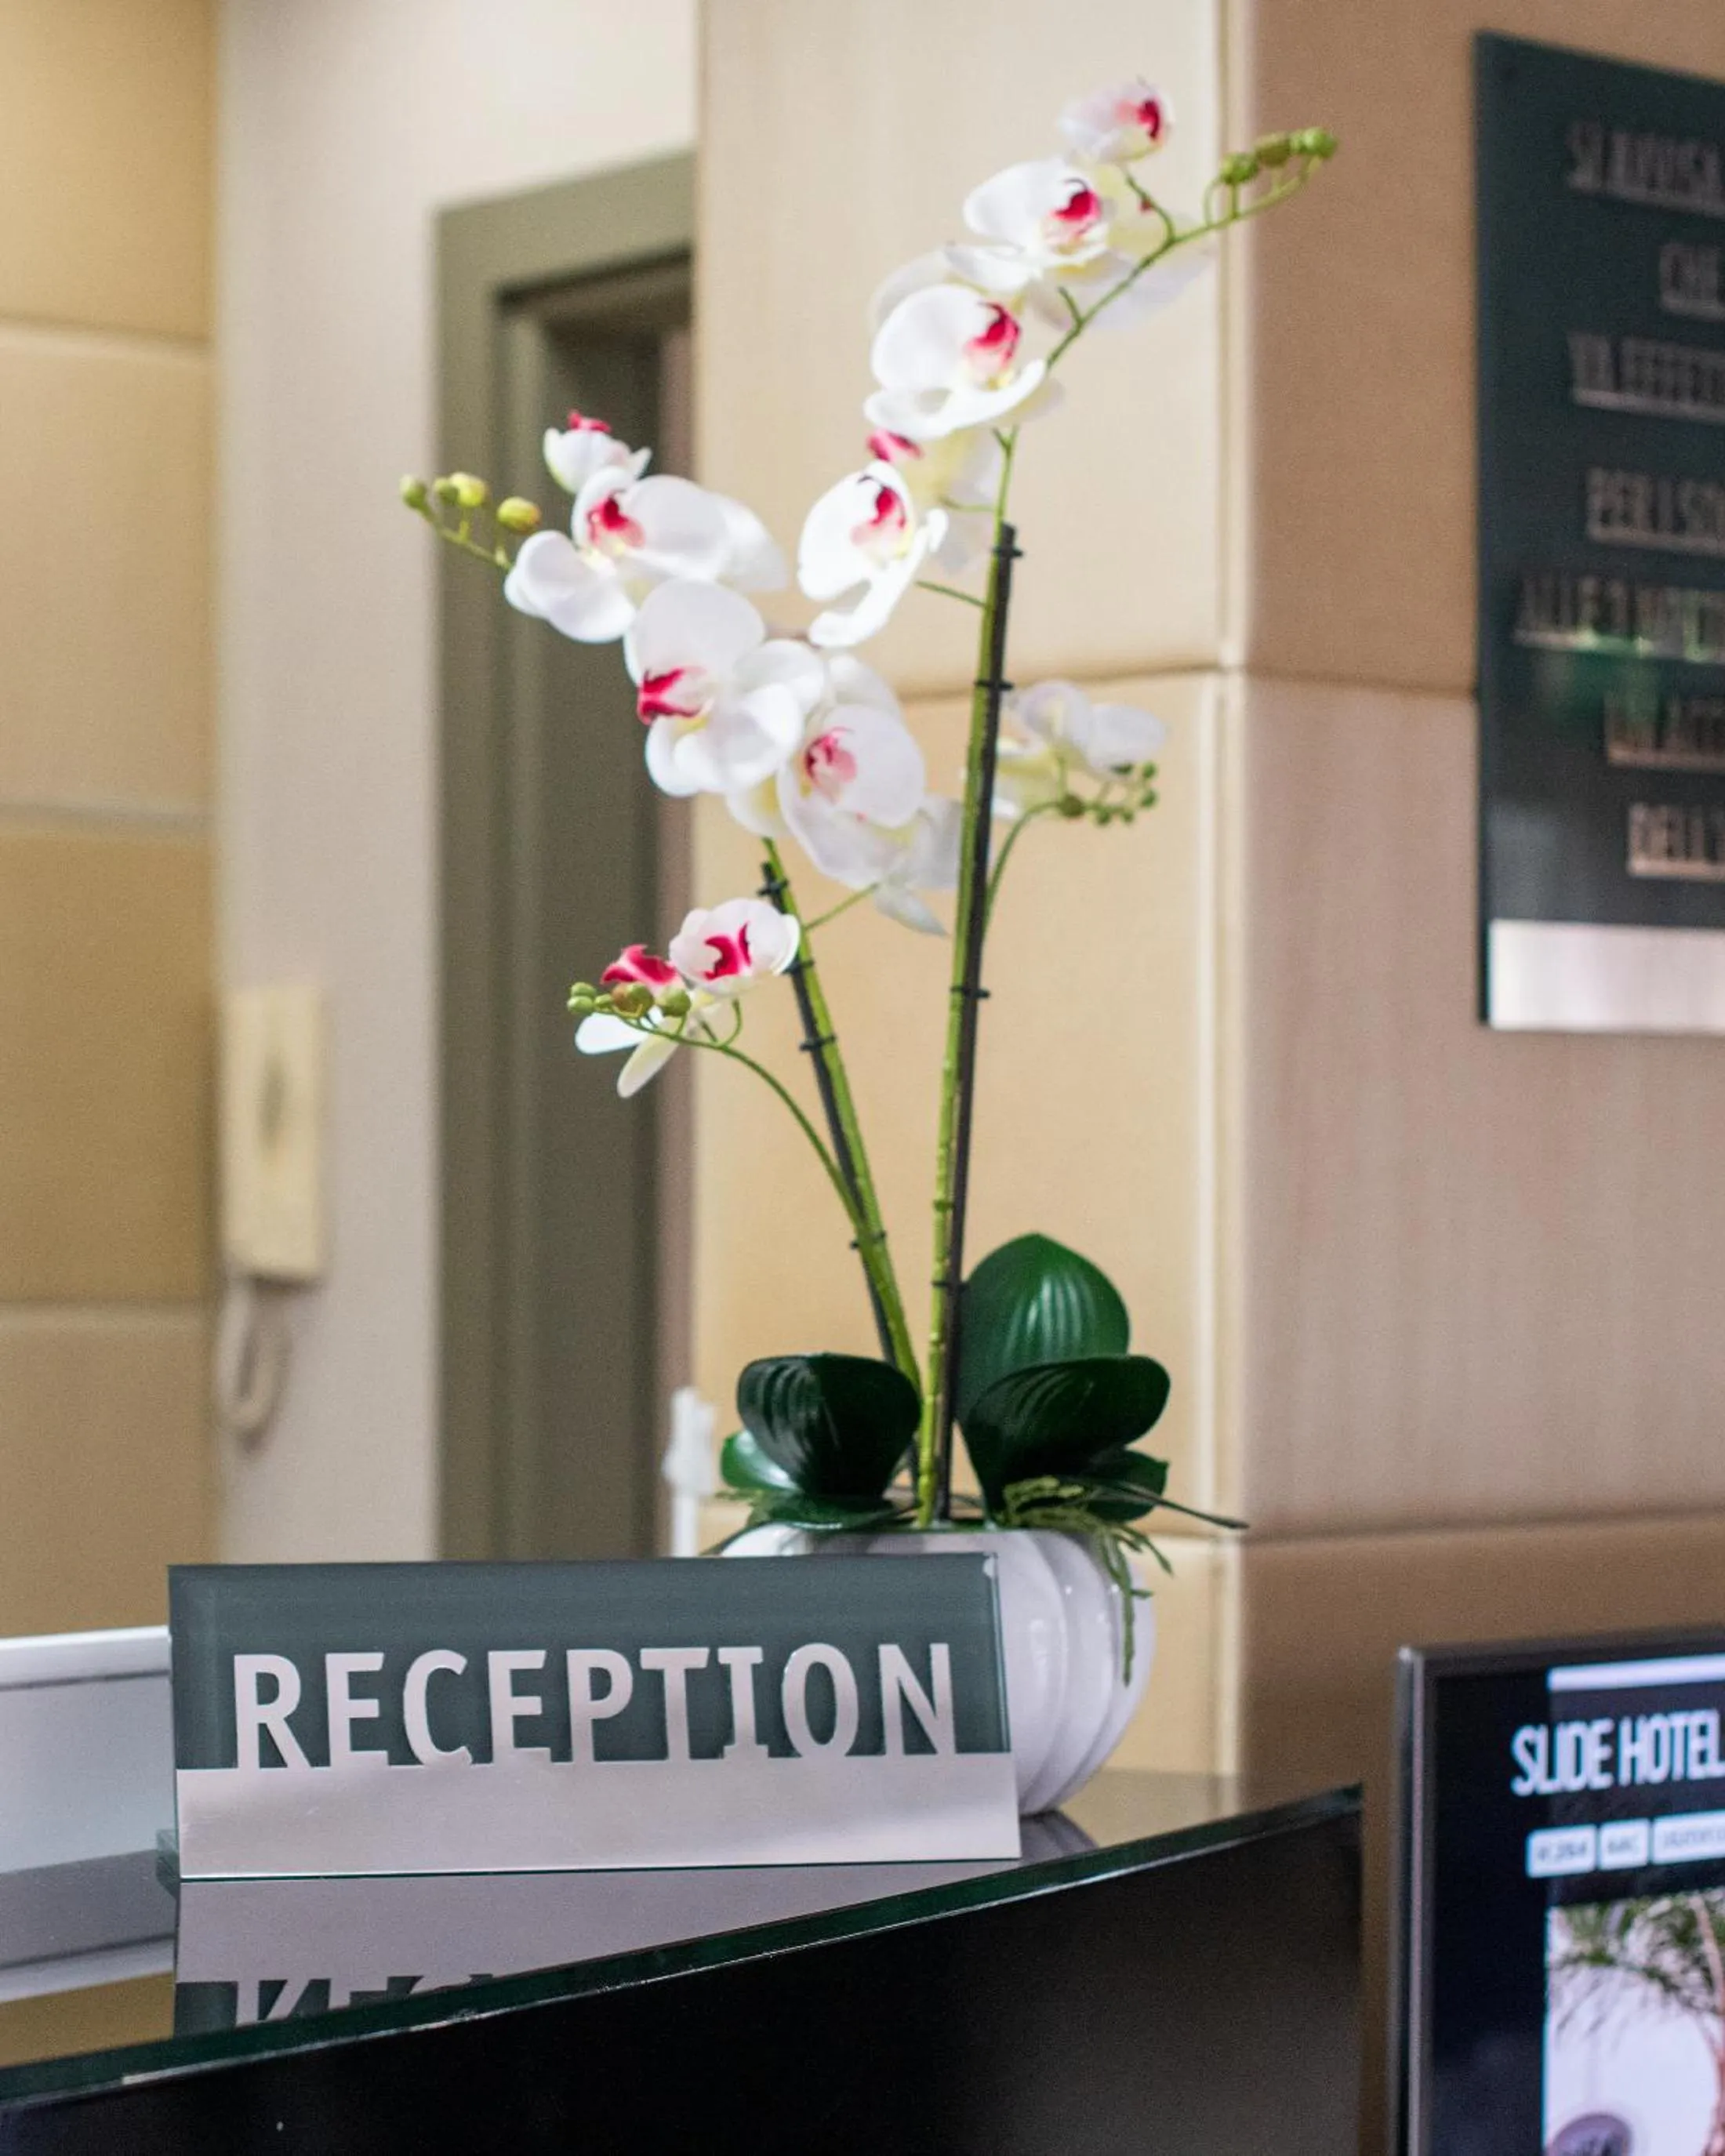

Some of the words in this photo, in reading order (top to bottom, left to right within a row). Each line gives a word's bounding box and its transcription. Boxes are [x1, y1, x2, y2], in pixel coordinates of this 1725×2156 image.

[233, 1642, 957, 1770] RECEPTION
[1510, 1717, 1614, 1797] SLIDE
[1618, 1708, 1725, 1787] HOTEL
